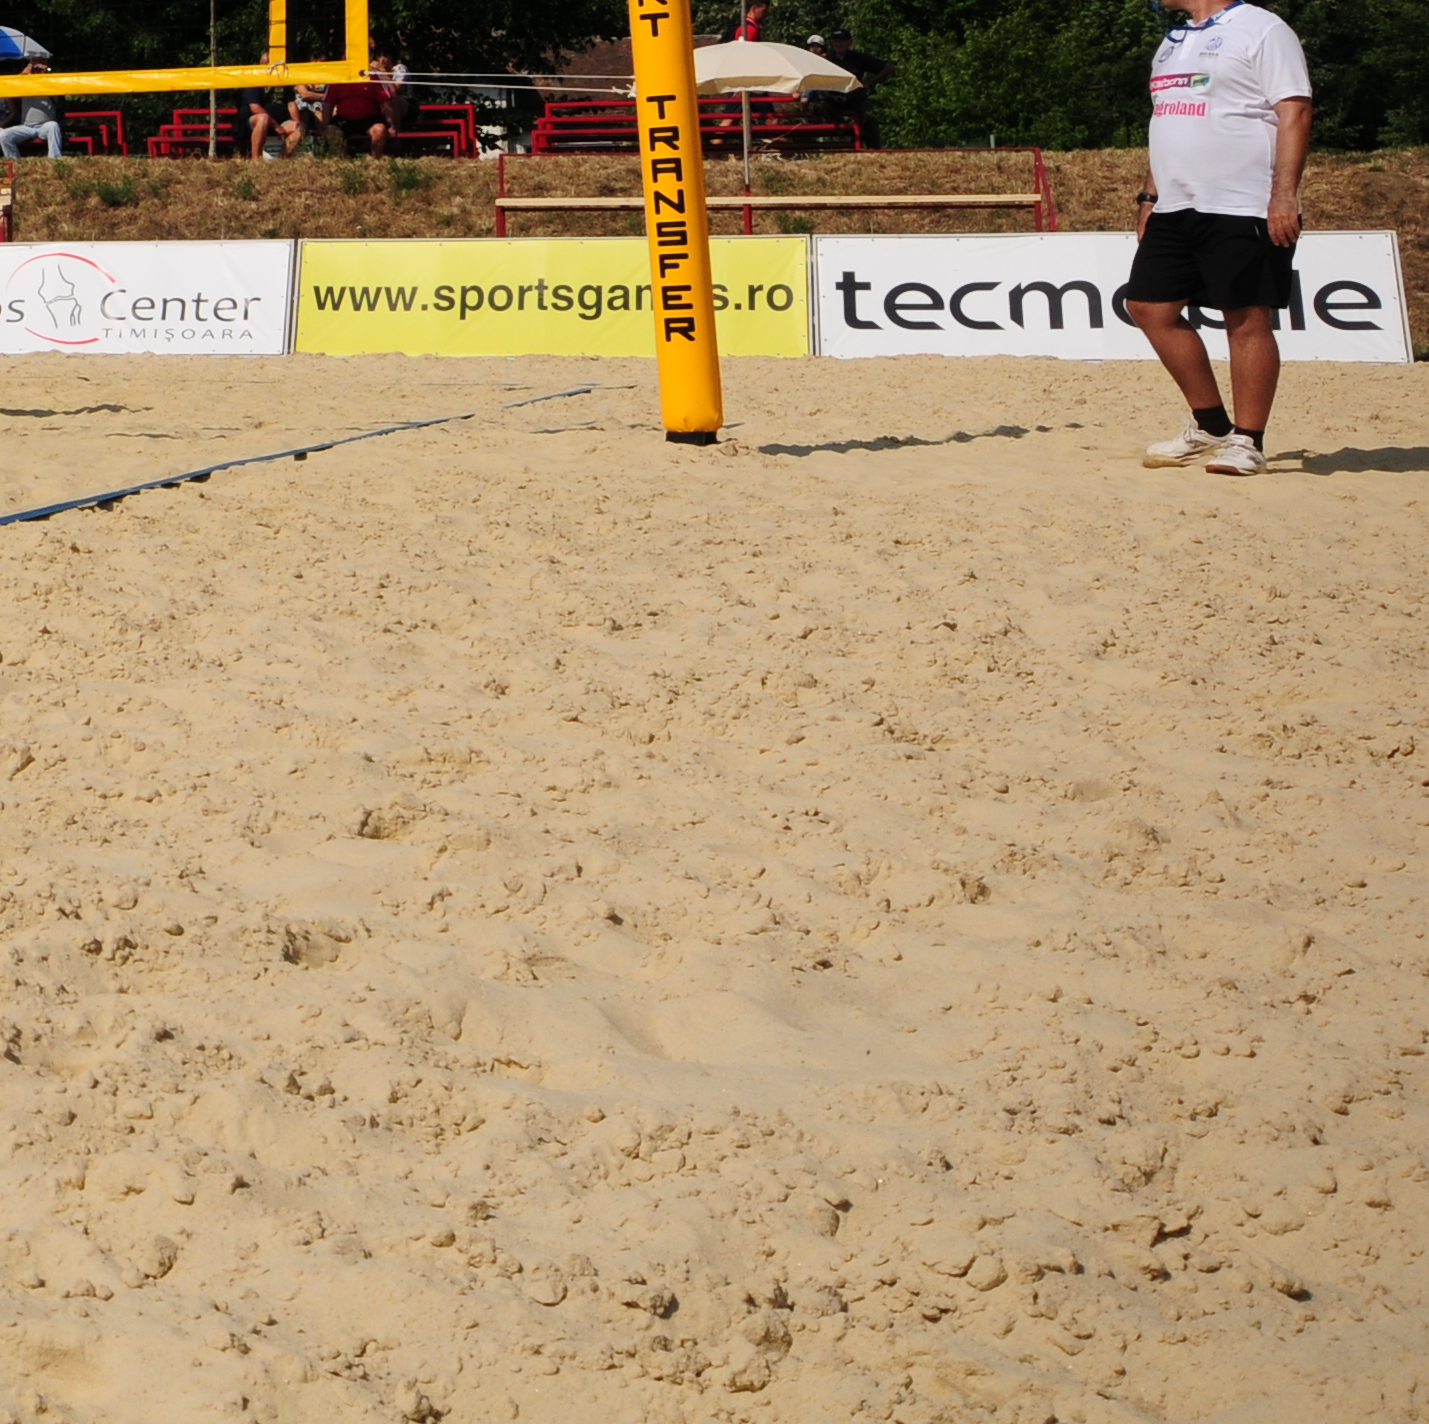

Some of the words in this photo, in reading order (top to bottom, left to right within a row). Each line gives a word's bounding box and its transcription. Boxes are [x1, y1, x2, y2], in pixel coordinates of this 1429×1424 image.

[646, 94, 696, 343] TRANSFER
[100, 288, 262, 323] Center
[313, 278, 794, 320] www.sportsgas.ro
